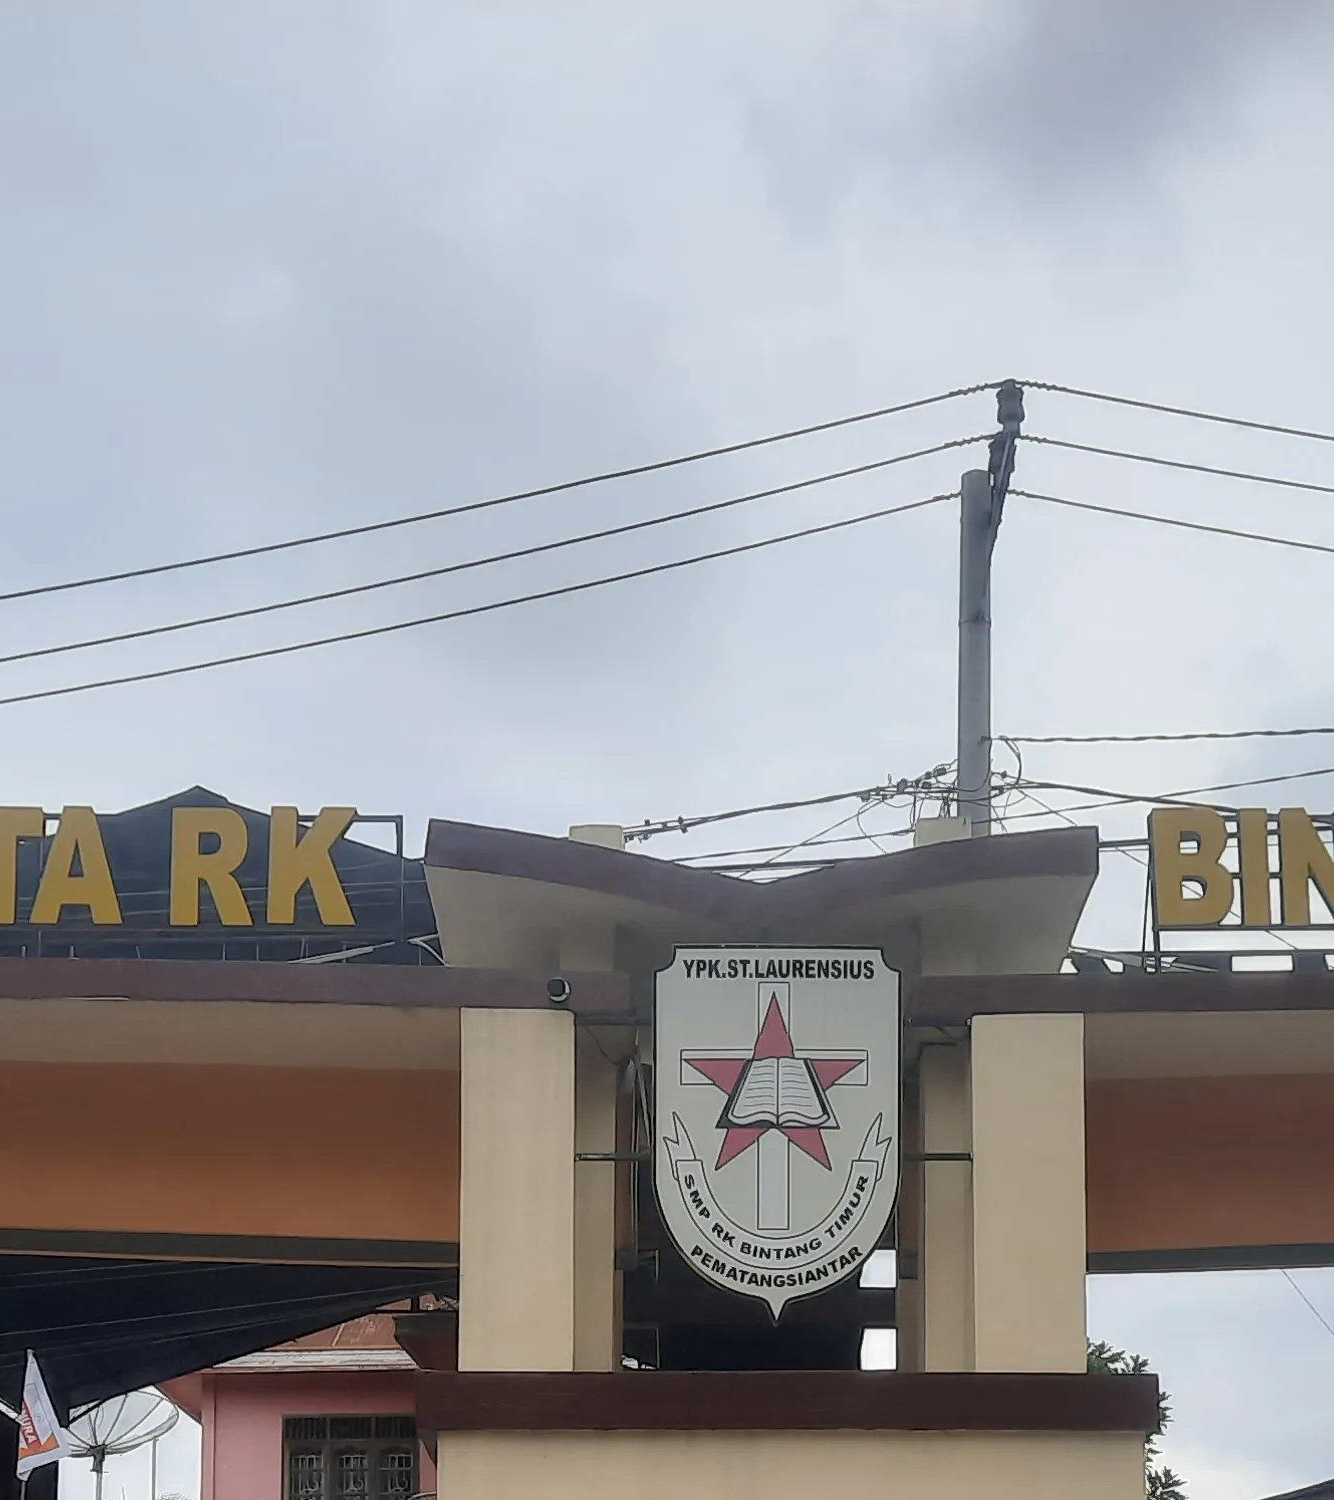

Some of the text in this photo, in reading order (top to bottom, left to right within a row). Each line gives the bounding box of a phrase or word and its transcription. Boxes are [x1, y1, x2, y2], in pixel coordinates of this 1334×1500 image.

[169, 806, 362, 928] RK
[682, 959, 875, 979] YPK.ST.LAURENSIUS
[684, 1173, 870, 1261] SMP RK BINTANG TIMUR
[690, 1244, 864, 1288] PEMATANGSIANTAR
